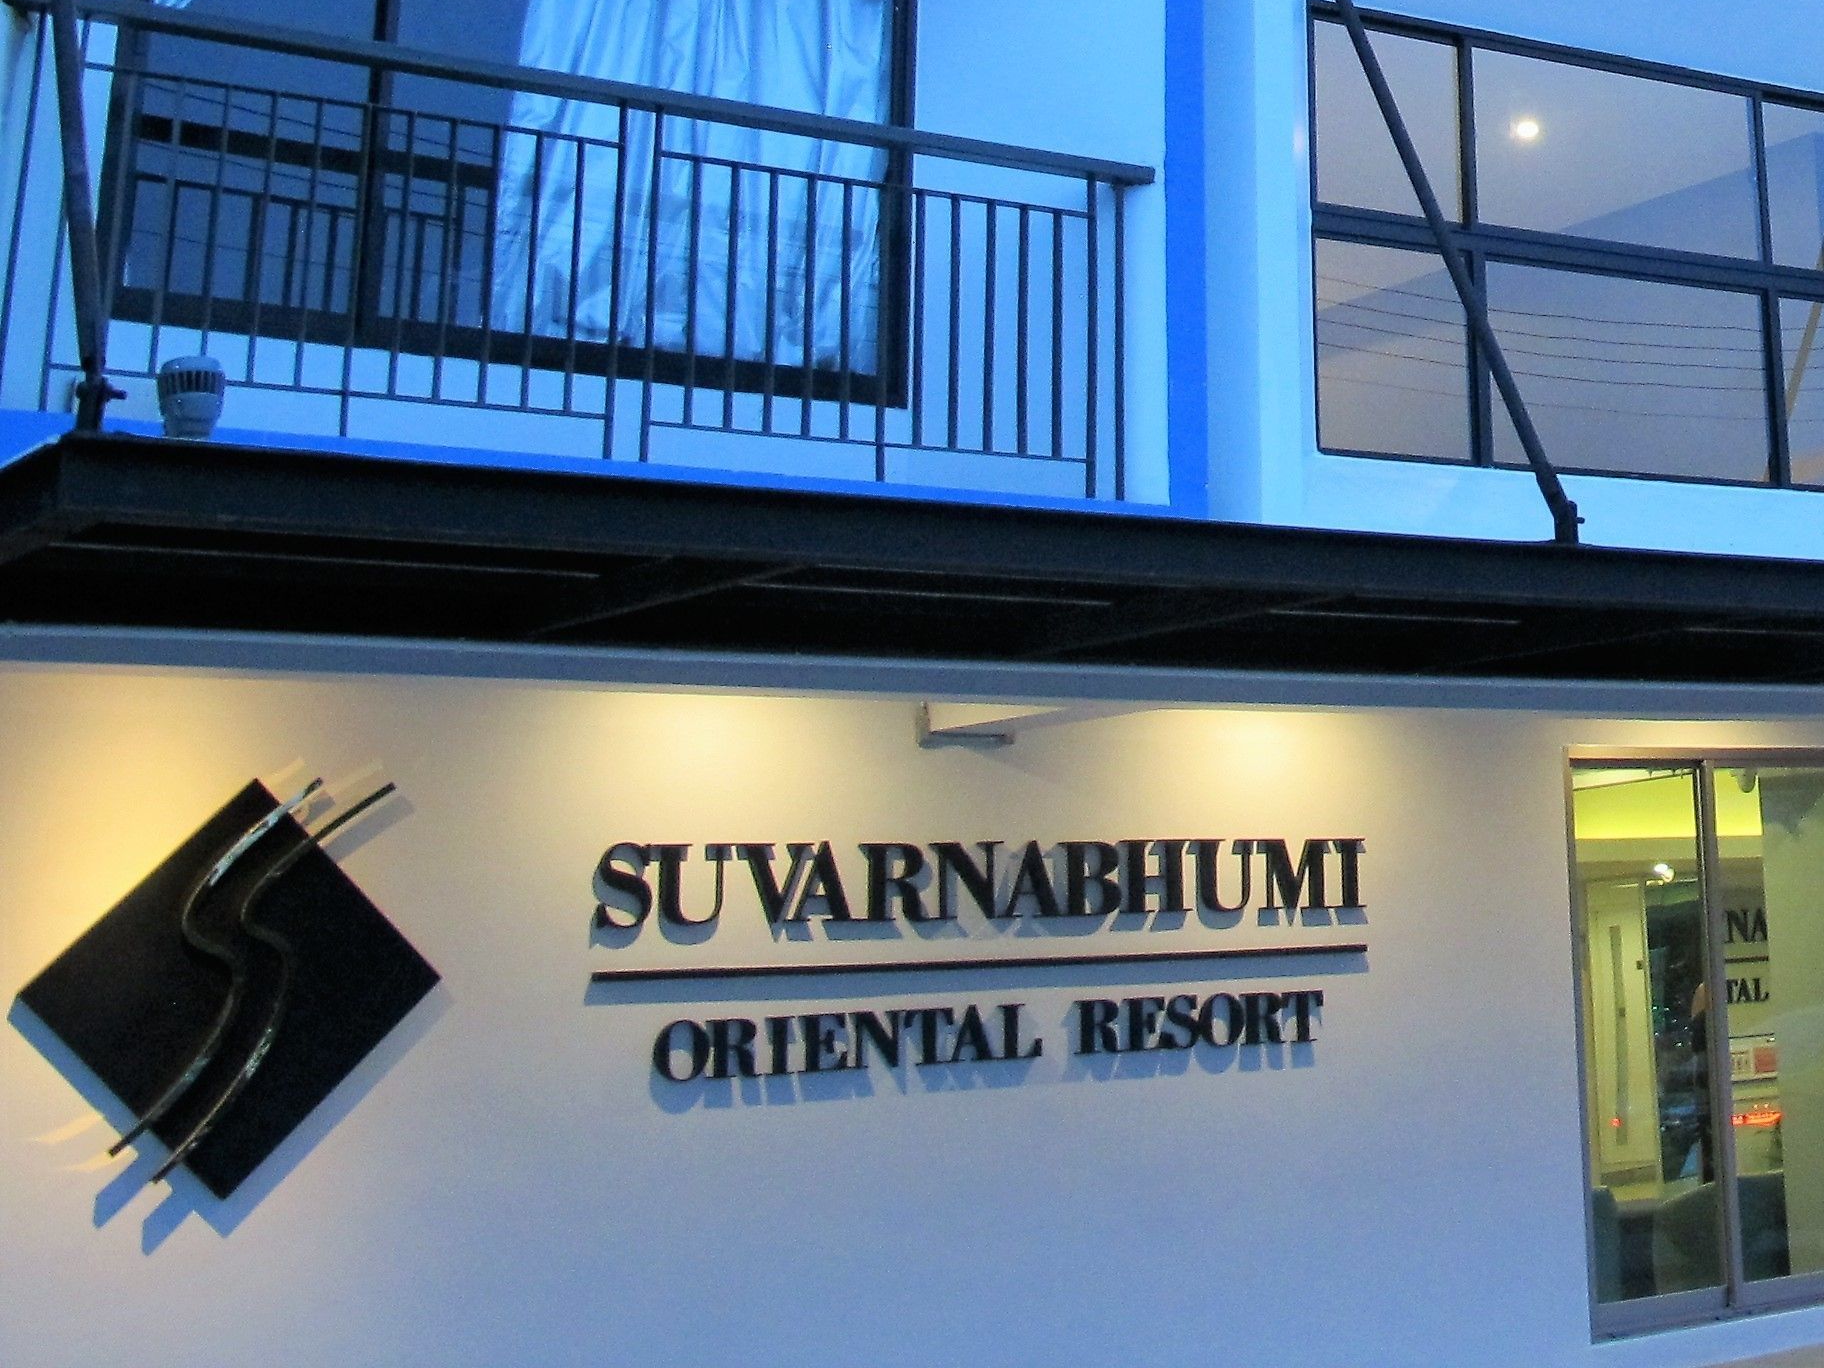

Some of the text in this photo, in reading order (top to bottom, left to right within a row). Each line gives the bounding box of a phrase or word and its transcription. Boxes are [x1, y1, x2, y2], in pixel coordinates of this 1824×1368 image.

[596, 838, 1368, 928] SUVARNABHUMI
[652, 989, 1325, 1081] ORIENTAL RESORT
